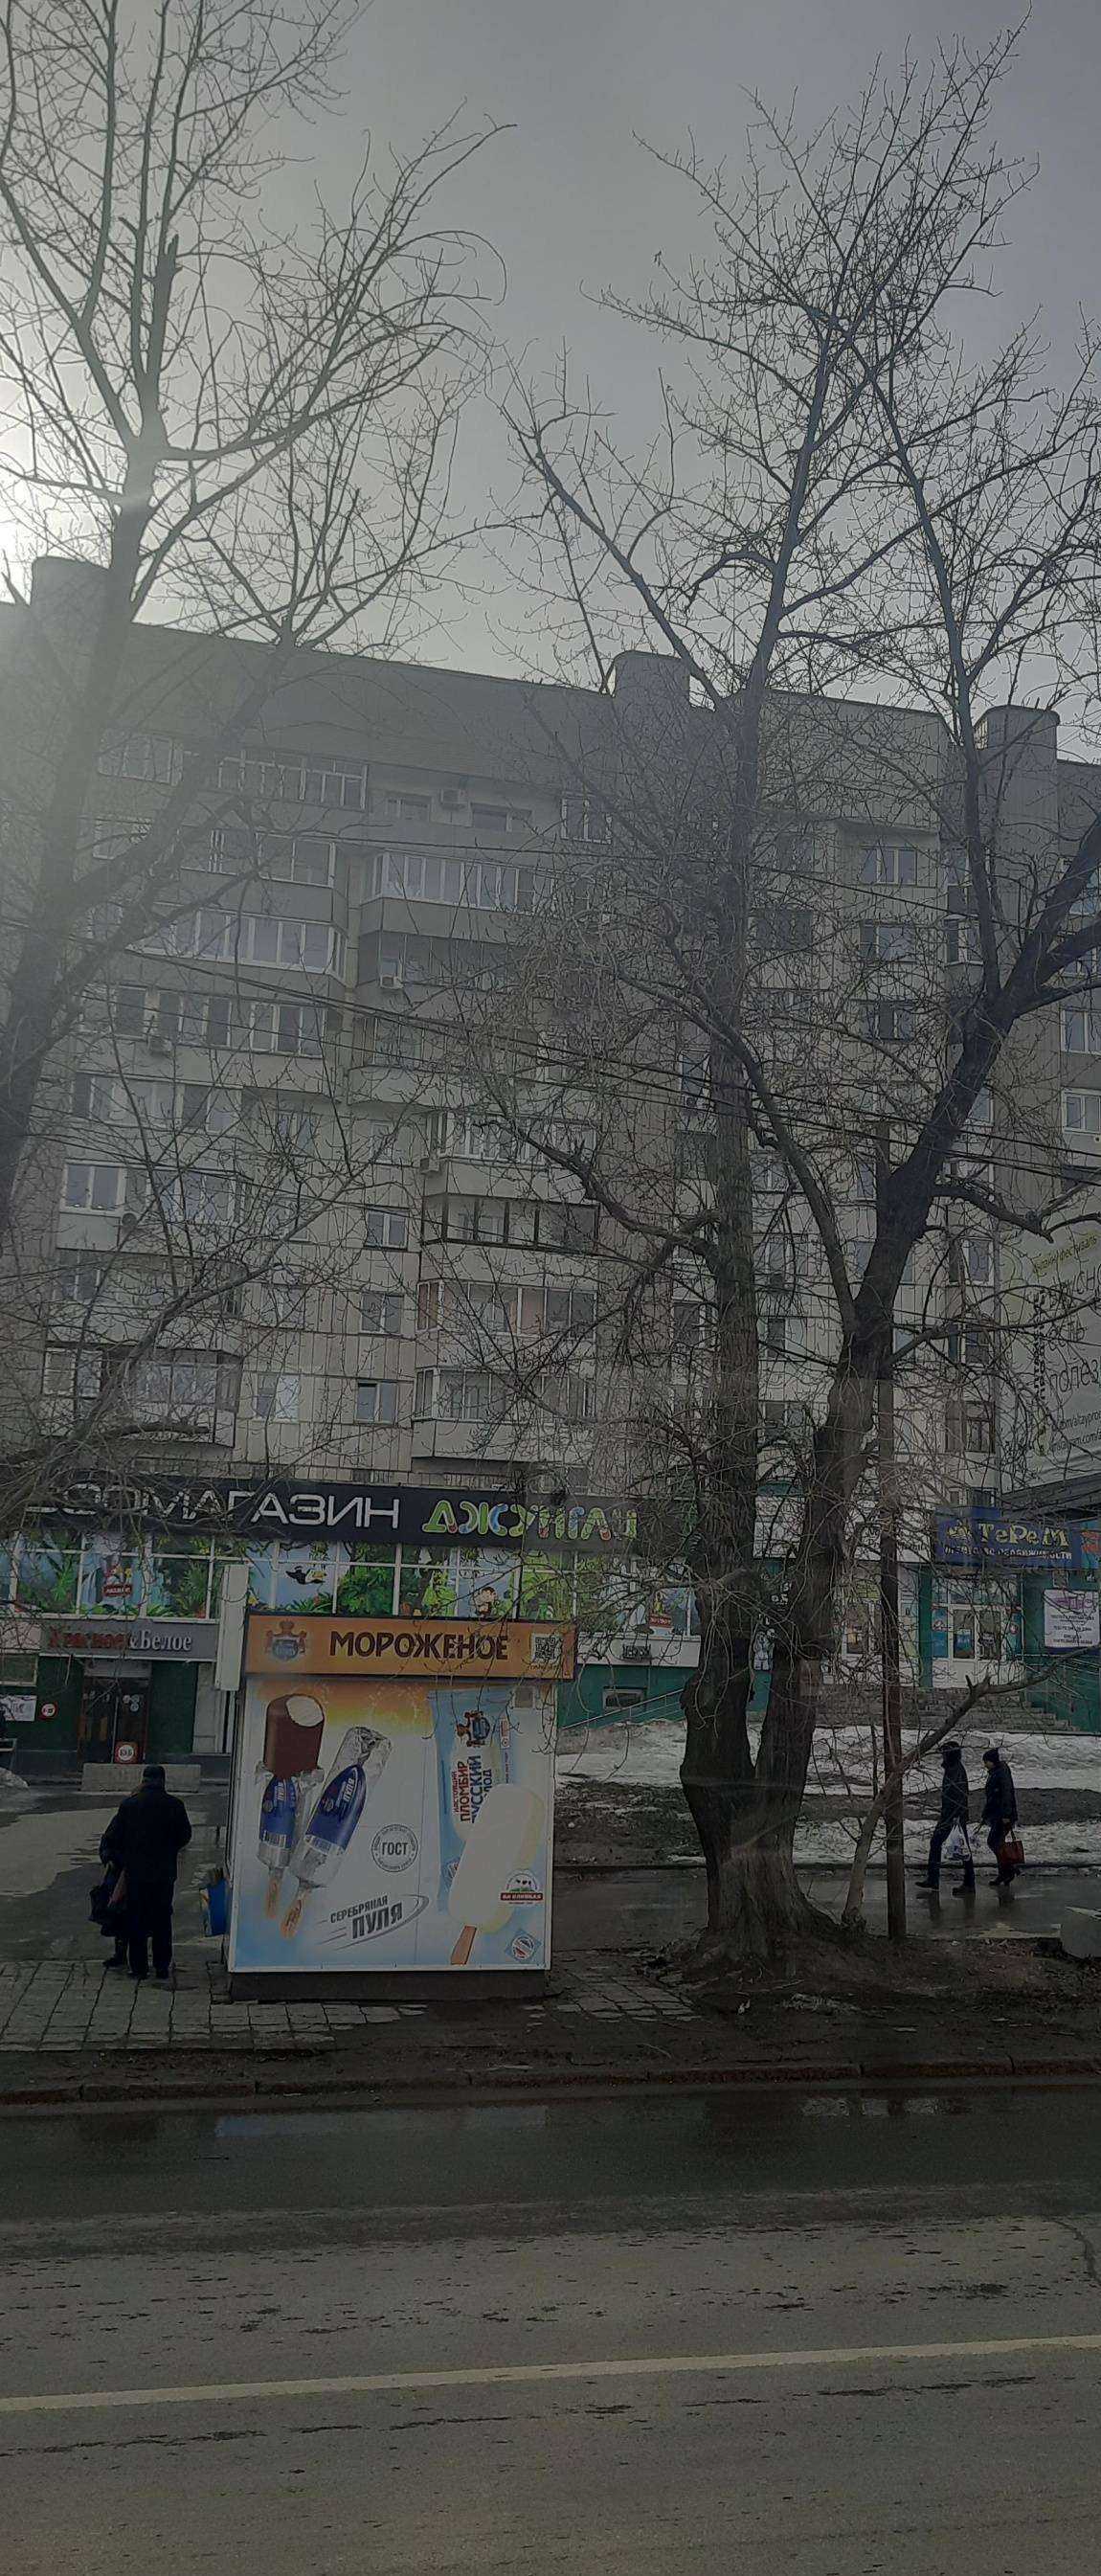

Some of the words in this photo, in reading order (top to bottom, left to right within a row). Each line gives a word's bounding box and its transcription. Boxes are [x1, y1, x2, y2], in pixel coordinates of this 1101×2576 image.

[25, 1481, 399, 1529] ООМАГАЗИН
[329, 1631, 508, 1661] МОРОЖЕНОЕ
[458, 1760, 471, 1822] ПЛОМБИР
[382, 1842, 408, 1856] ГОСТ
[330, 1895, 388, 1923] СЕРЕБРЯНАЯ
[352, 1903, 403, 1939] ПУЛЯ
